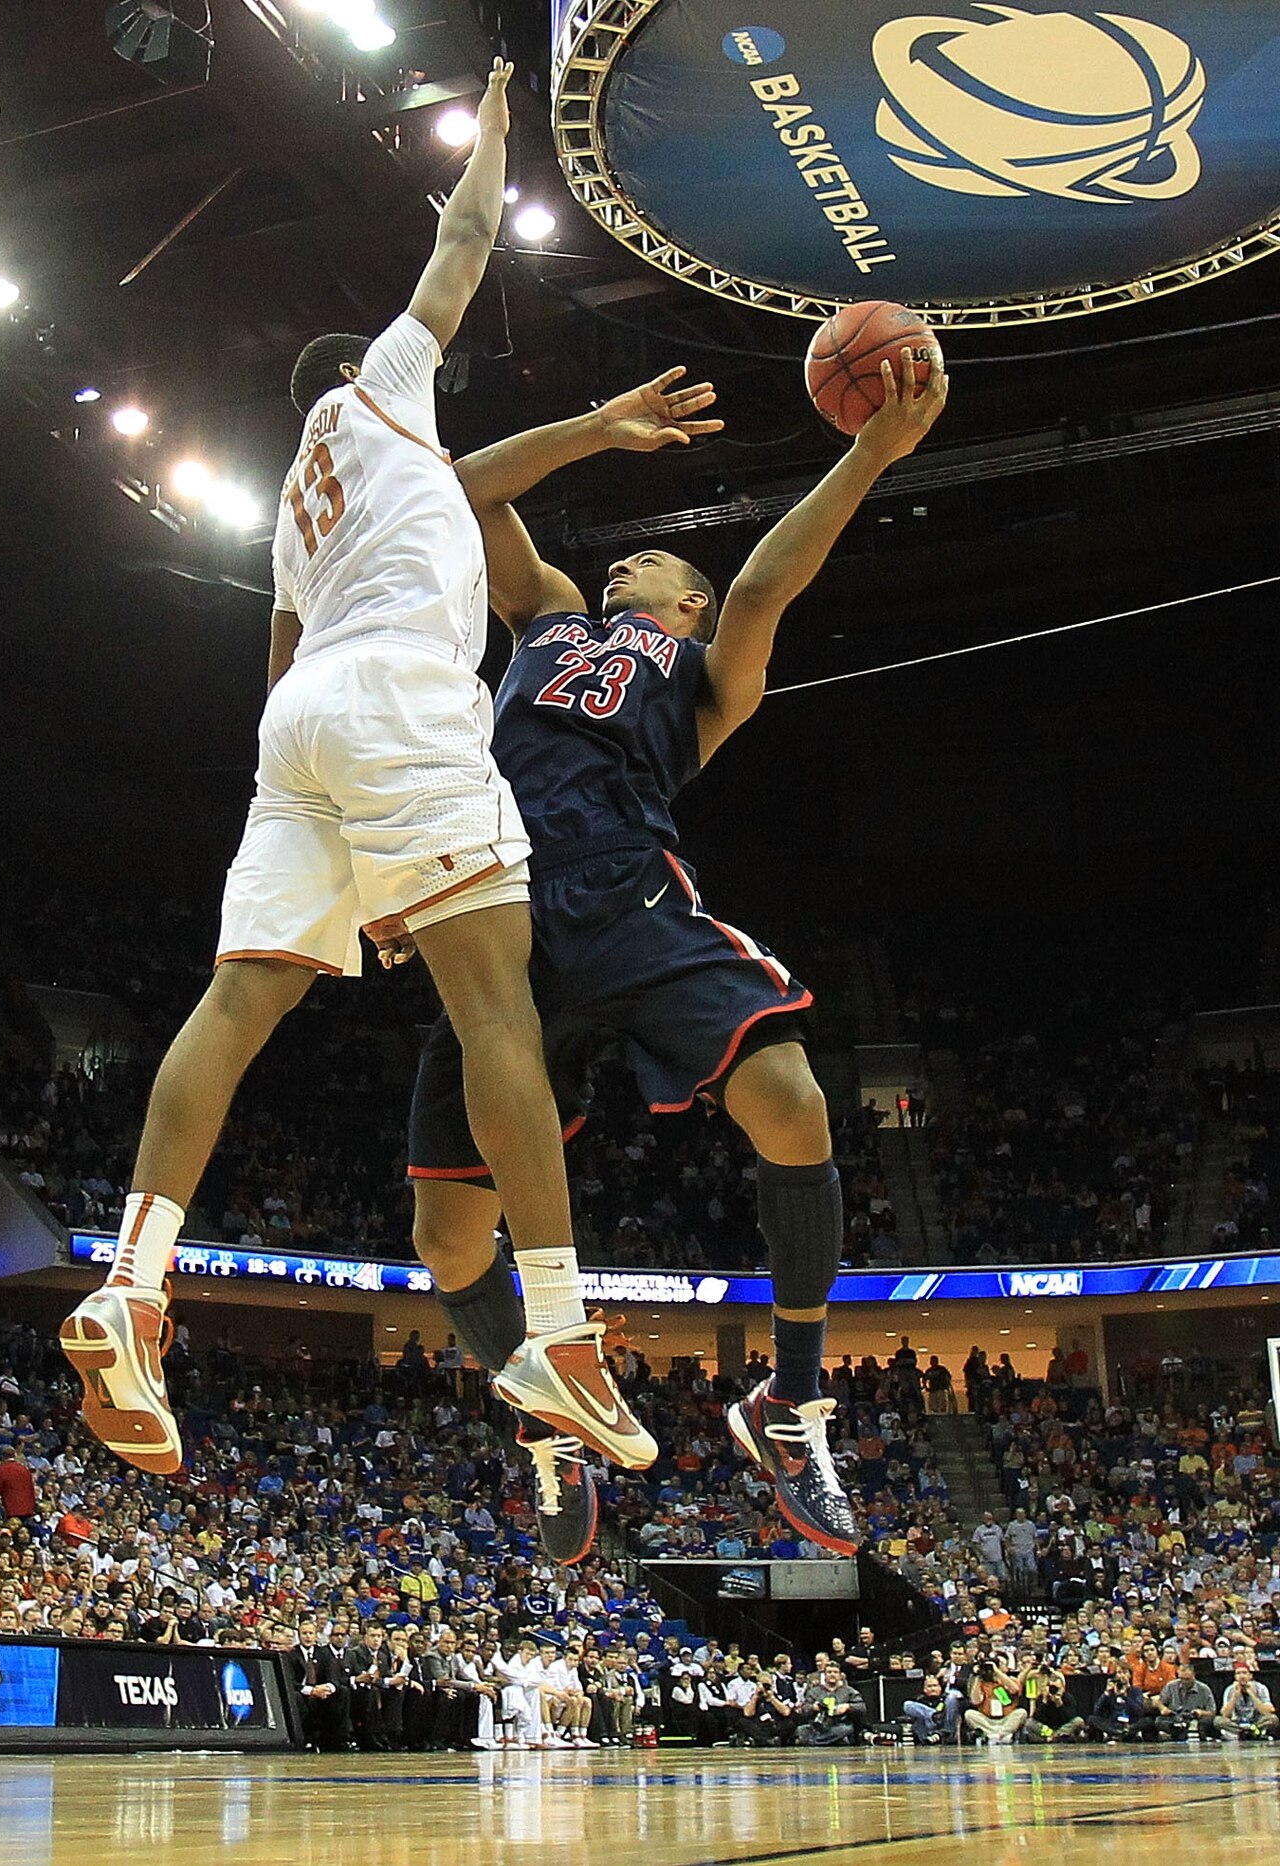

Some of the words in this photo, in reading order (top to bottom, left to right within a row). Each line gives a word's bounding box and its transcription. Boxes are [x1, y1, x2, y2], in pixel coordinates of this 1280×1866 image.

[731, 31, 764, 66] NCAA
[749, 73, 897, 274] BASKETBALL
[287, 442, 345, 561] 13
[533, 650, 637, 719] 23
[90, 1241, 116, 1263] 25
[407, 1272, 432, 1291] 36
[579, 1273, 599, 1287] 011
[600, 1273, 693, 1289] BASKETBALL
[581, 1286, 695, 1302] HAMPIONSHIP
[1010, 1272, 1079, 1296] NCAA
[114, 1675, 178, 1706] TEXAS
